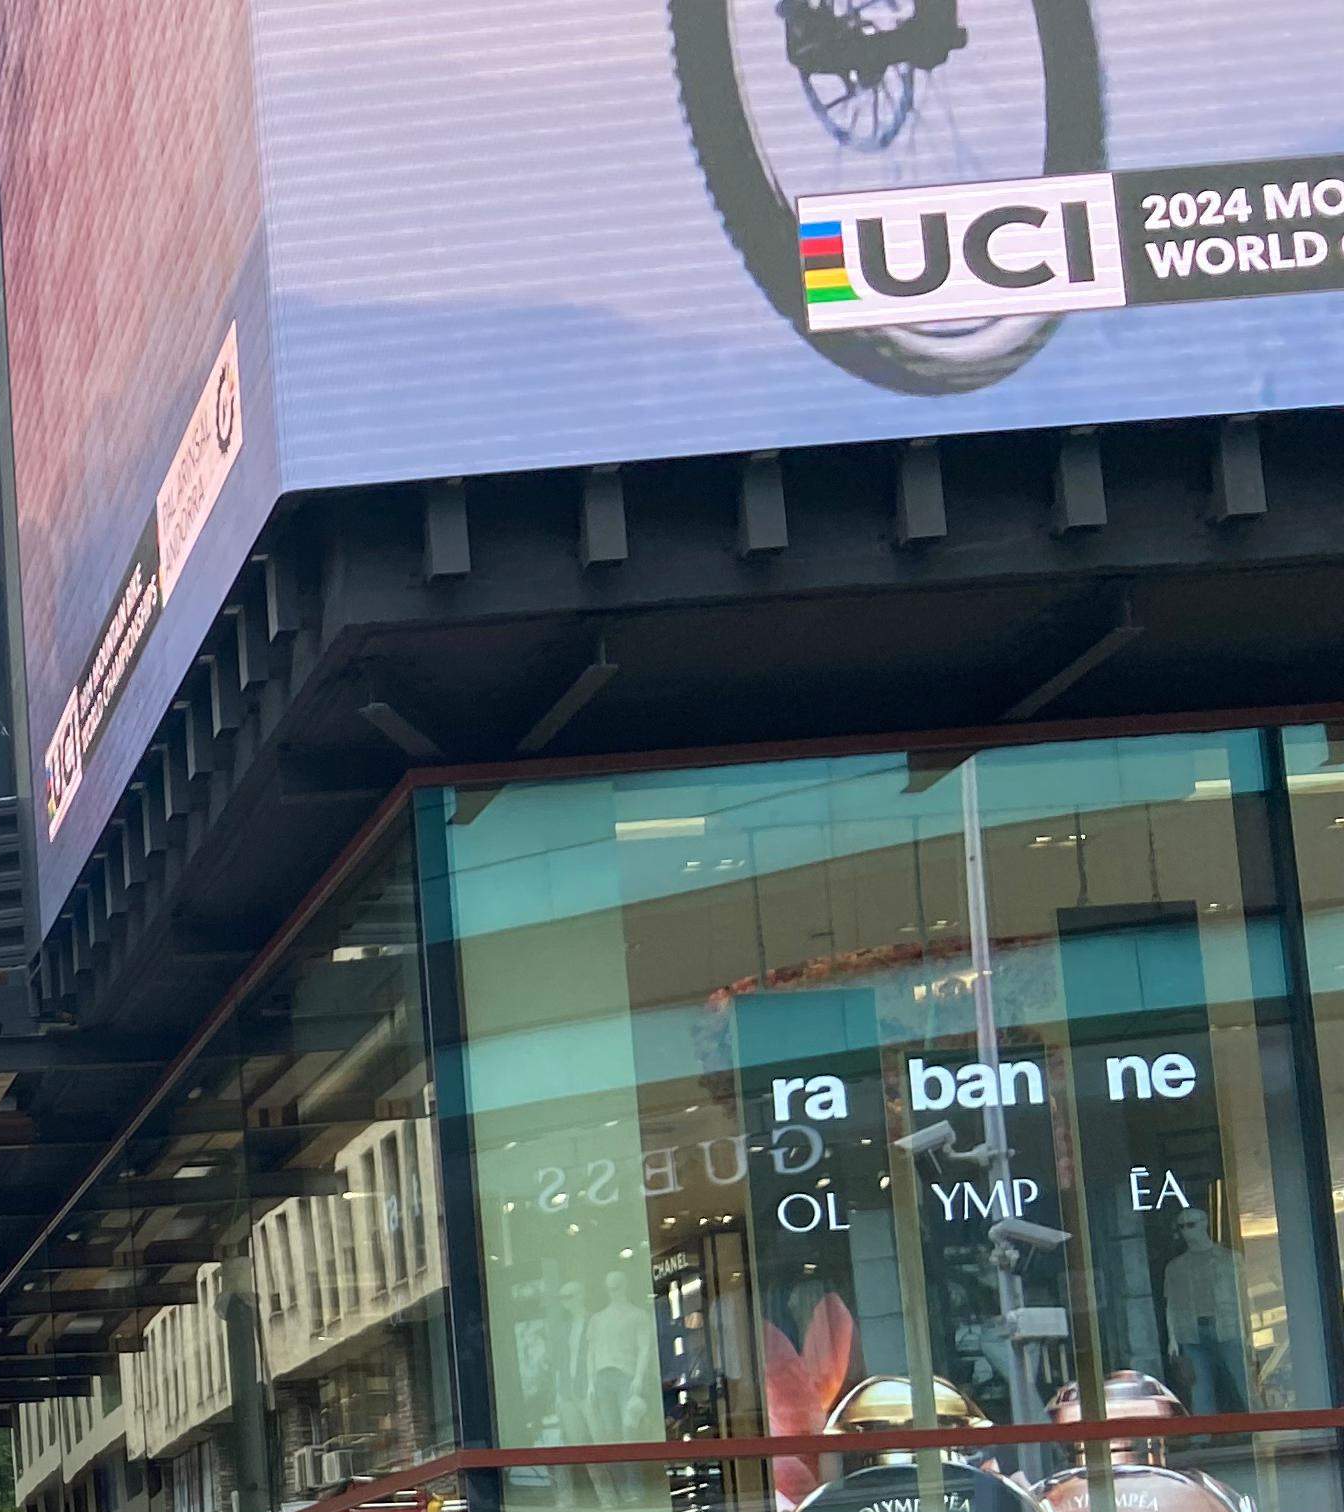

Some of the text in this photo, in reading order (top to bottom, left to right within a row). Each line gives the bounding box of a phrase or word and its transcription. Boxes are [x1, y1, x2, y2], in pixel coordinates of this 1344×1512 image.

[1141, 186, 1254, 231] 2024
[855, 200, 1096, 298] UCI
[1143, 230, 1329, 280] WORLD
[52, 706, 77, 813] UCI
[771, 1052, 1198, 1122] ra ban ne
[776, 1192, 852, 1233] OL
[930, 1178, 1039, 1222] YMP
[652, 1252, 689, 1280] CHANEL
